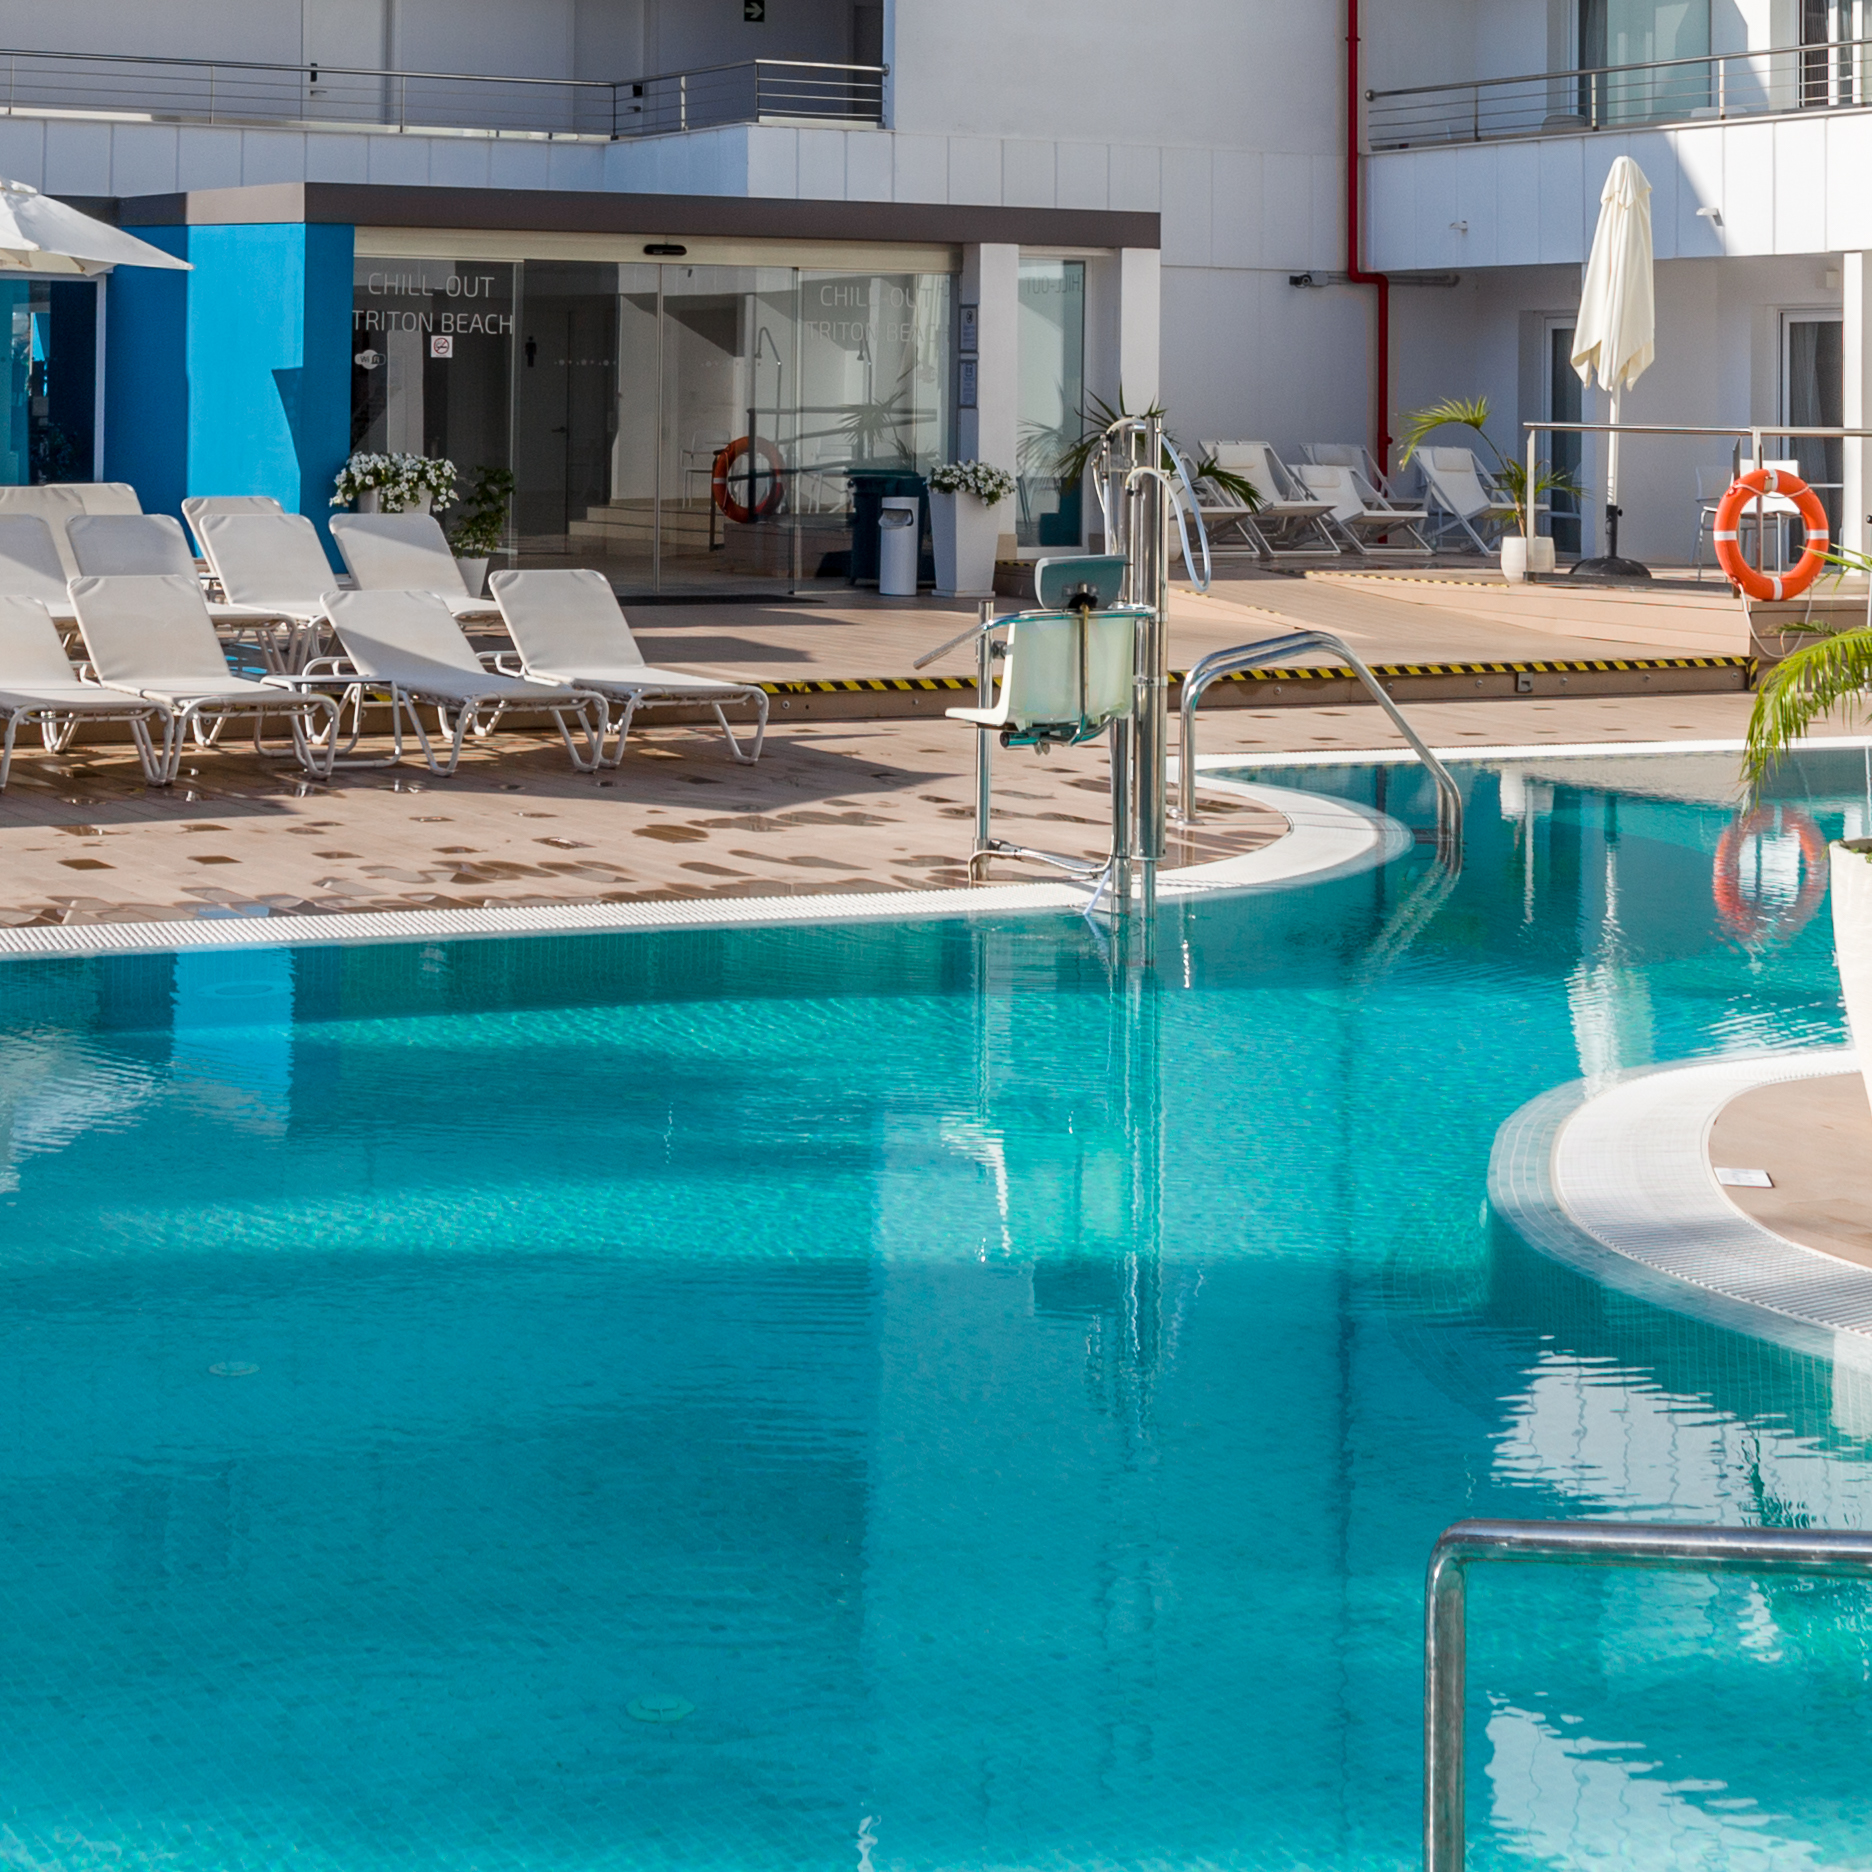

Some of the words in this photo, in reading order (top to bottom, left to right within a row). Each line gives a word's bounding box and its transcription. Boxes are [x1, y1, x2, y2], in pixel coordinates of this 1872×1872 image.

[368, 272, 496, 298] CHILL-OUT
[352, 309, 434, 333] TRITON
[441, 312, 514, 335] BEACH
[804, 320, 877, 342] TRITON
